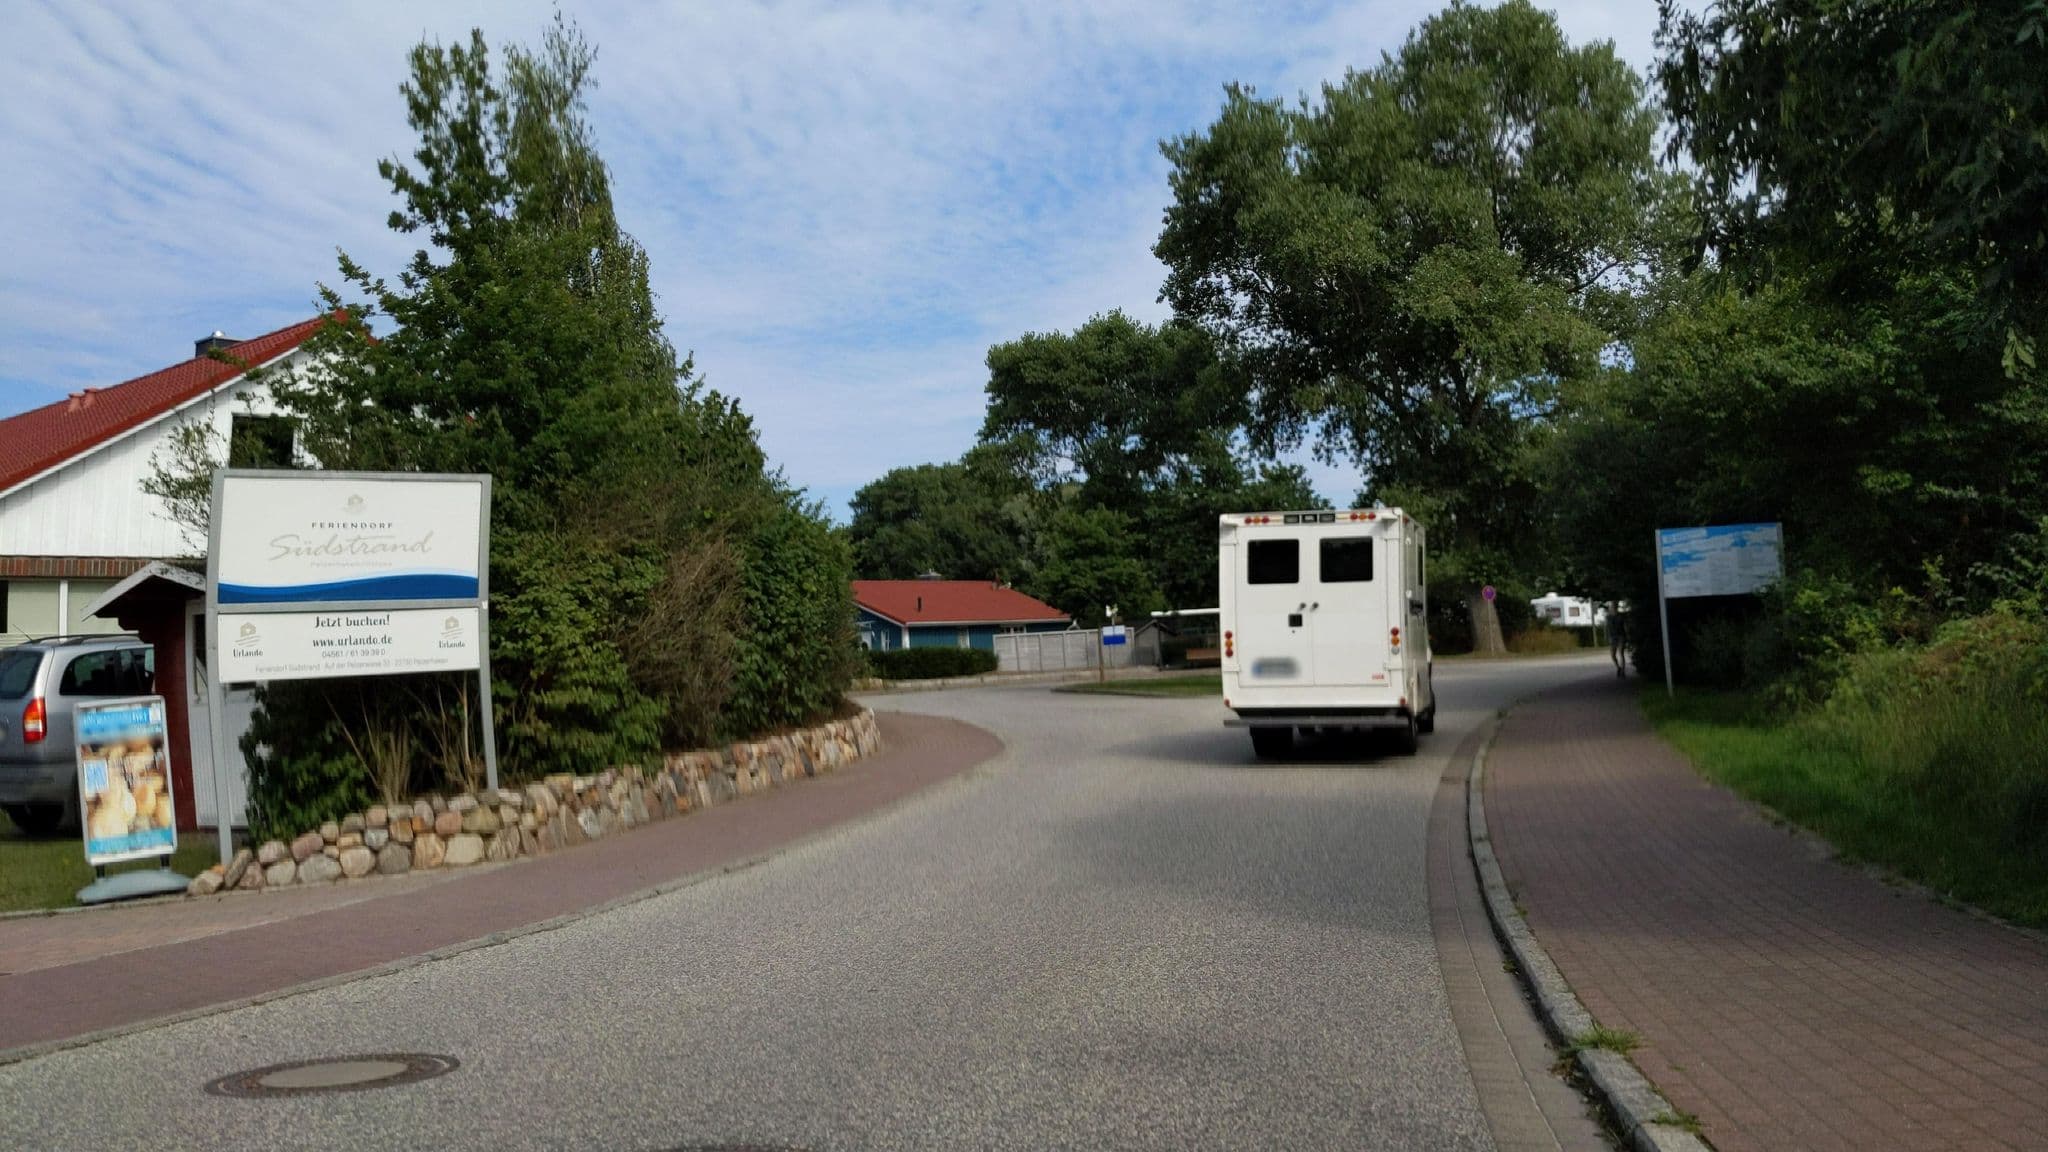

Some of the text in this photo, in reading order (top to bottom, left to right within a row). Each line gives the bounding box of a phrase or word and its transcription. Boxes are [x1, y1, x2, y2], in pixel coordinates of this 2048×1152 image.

[311, 521, 394, 530] FERIENDORF
[268, 530, 435, 562] Südstrand
[315, 614, 391, 629] Jetzt buchen!
[312, 635, 393, 648] www.urlando.de
[232, 647, 264, 658] Urlando
